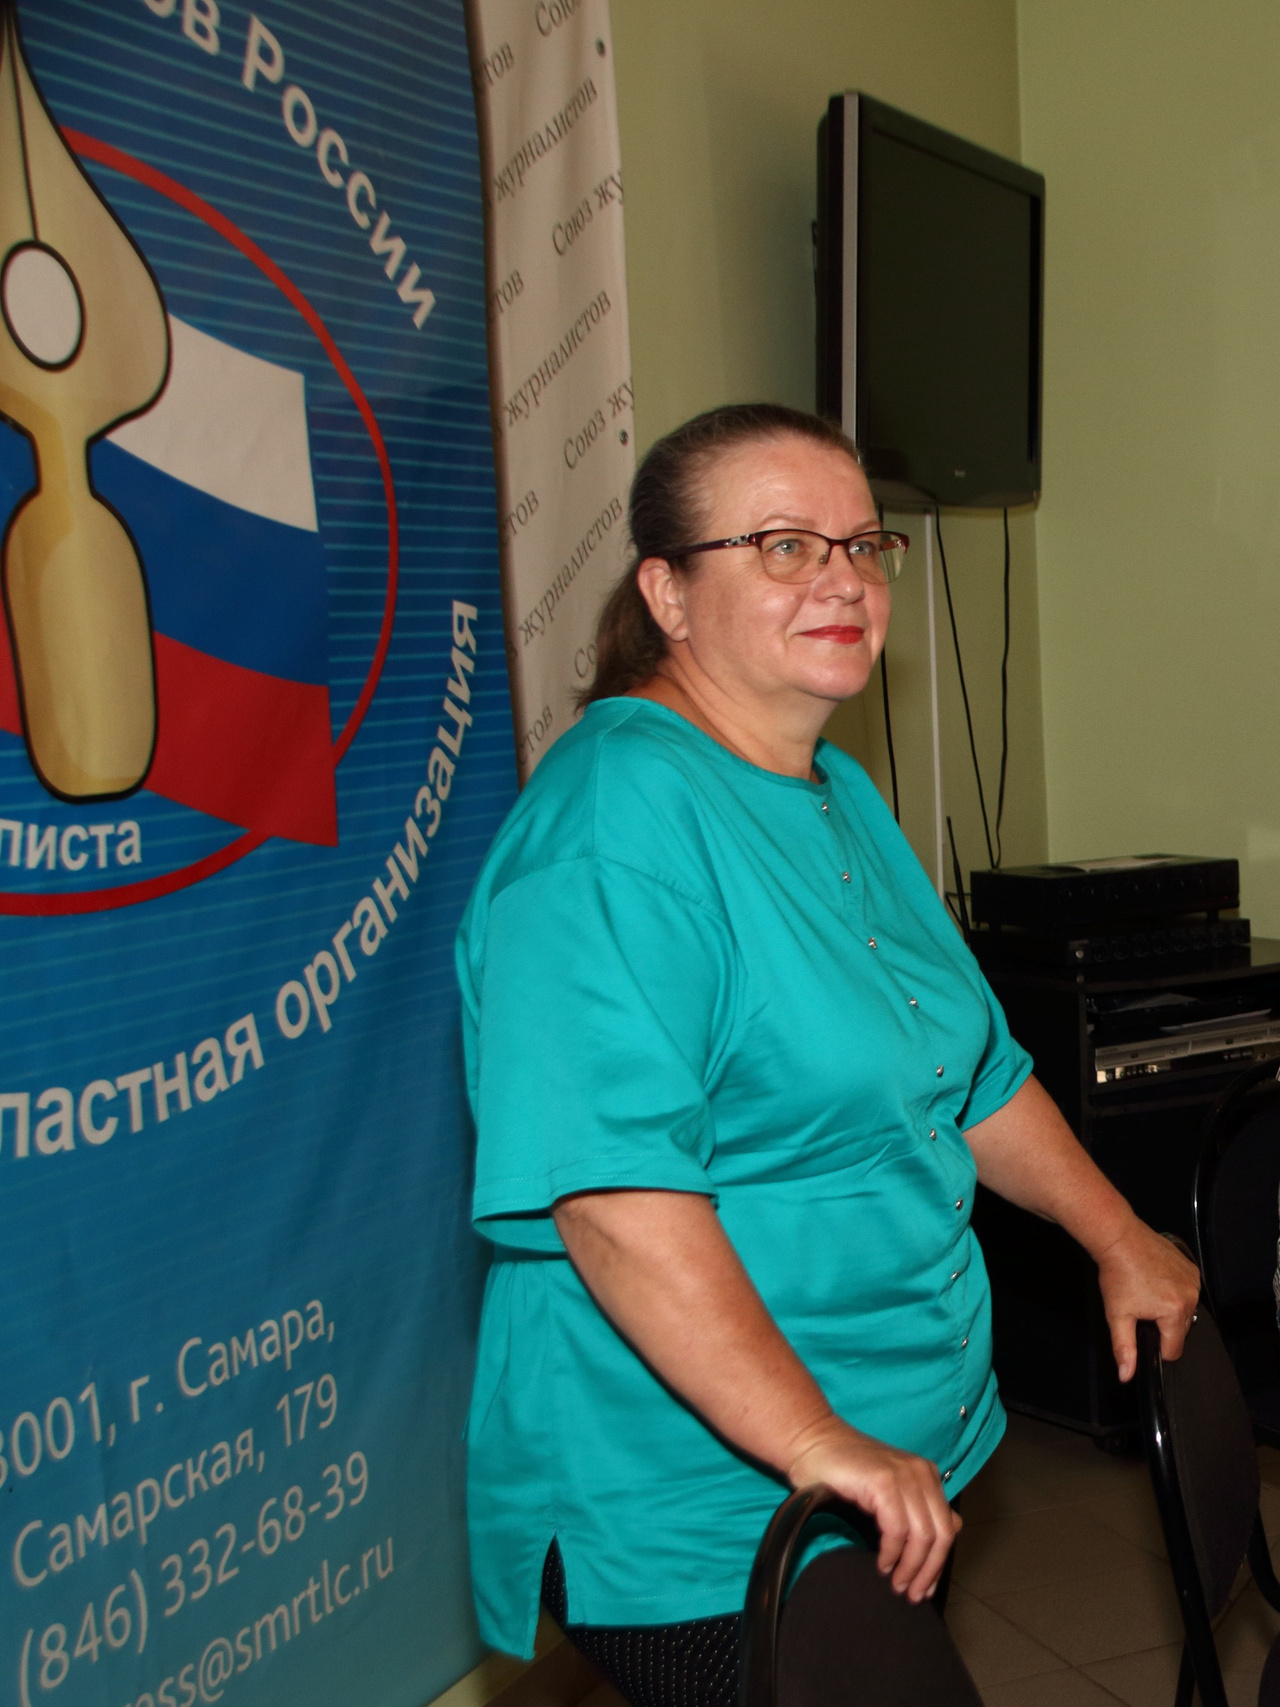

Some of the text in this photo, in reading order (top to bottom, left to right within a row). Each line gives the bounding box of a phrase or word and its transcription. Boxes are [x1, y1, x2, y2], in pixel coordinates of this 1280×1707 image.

[552, 199, 594, 257] Союз
[502, 289, 612, 427] журналистов
[563, 409, 607, 470] Союз
[517, 496, 624, 647] журналистов
[275, 598, 478, 1040] организация
[0, 1299, 335, 1490] 001, г. Самара,
[13, 1373, 338, 1587] Самарская, 179
[19, 1450, 369, 1707] (846) 332-68-39
